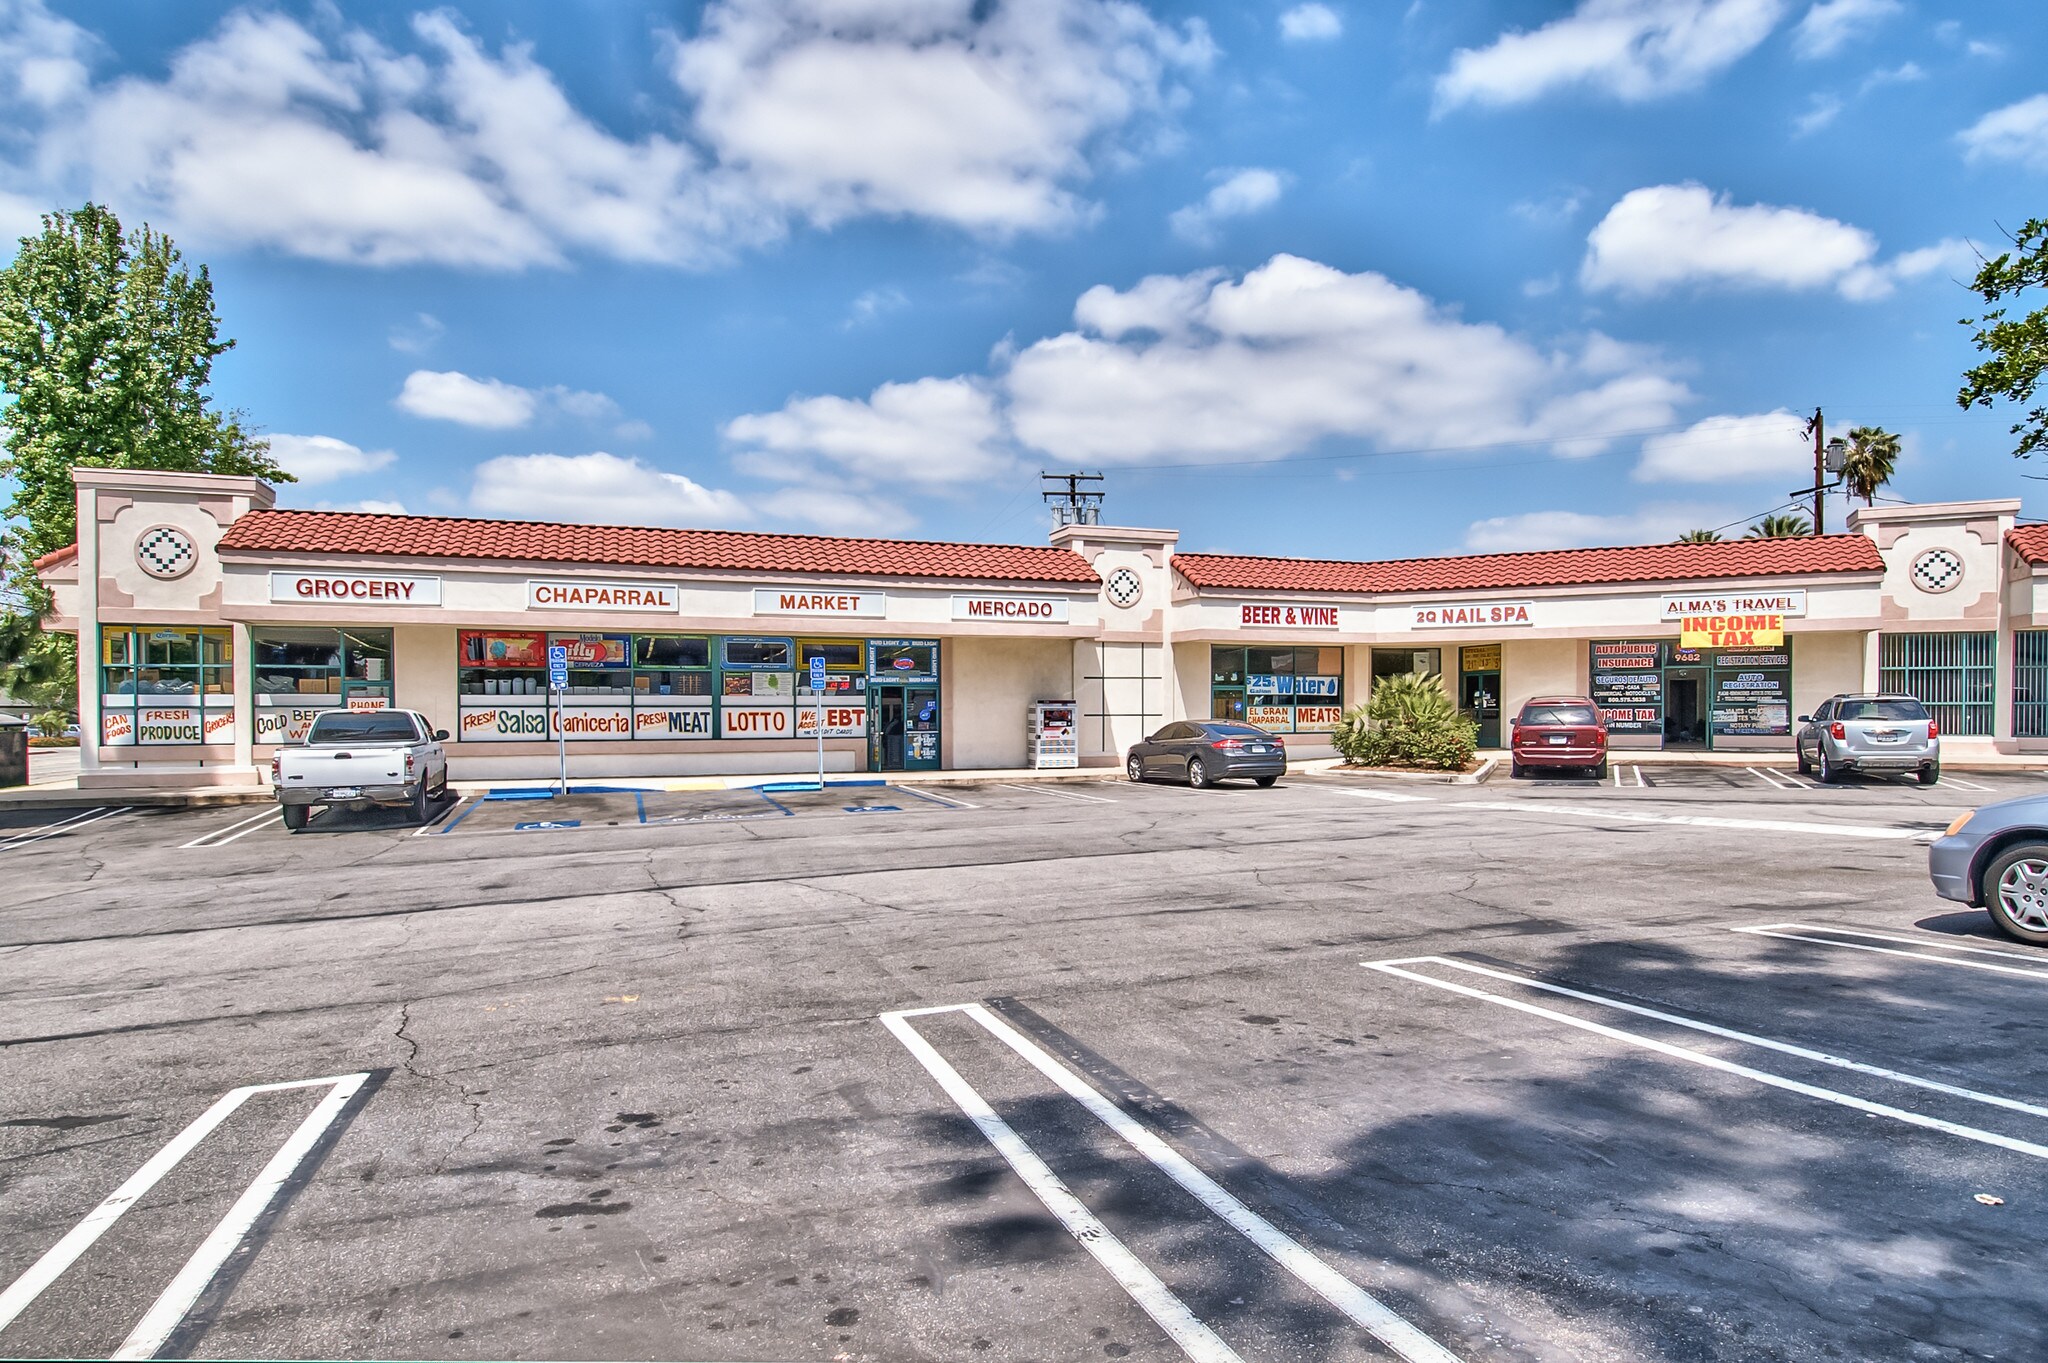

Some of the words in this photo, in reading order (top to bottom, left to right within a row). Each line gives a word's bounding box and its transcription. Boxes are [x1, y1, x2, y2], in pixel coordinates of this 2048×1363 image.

[296, 578, 415, 598] GROCERY
[535, 586, 671, 606] CHAPARRAL
[780, 594, 860, 611] MARKET
[968, 600, 1053, 617] MERCADO
[1668, 600, 1727, 613] ALMA'S
[1732, 597, 1797, 611] TRAVEL
[1242, 605, 1281, 624] BEER
[1285, 606, 1297, 625] &
[1300, 607, 1339, 625] WINE
[1442, 608, 1487, 624] NAIL
[1490, 606, 1529, 622] SPA
[1683, 615, 1781, 632] INCOME
[1708, 631, 1755, 646] TAX
[1598, 658, 1654, 668] INSURANCE
[1674, 653, 1701, 662] 9682
[1716, 656, 1760, 665] REGISTRATION
[1760, 655, 1788, 665] SERVICES
[1276, 675, 1326, 694] Water
[1596, 675, 1628, 684] SEGUROS
[1628, 675, 1639, 684] DE
[1722, 681, 1779, 689] REGISTRATION
[1737, 673, 1764, 681] AUTO
[146, 710, 190, 721] FRESH
[801, 711, 816, 721] WE
[827, 709, 865, 727] EBT
[1249, 708, 1259, 716] EL
[1297, 708, 1341, 723] MEATS
[1600, 709, 1633, 721] NCOME
[1635, 708, 1656, 721] TAX
[104, 714, 128, 730] CAN
[256, 714, 288, 735] COLD
[463, 710, 497, 731] FRESH
[497, 709, 546, 734] Salsa
[636, 711, 668, 730] FRESH
[668, 711, 711, 733] MEAT
[727, 711, 785, 731] LOTTO
[797, 719, 825, 730] ACCET
[1247, 716, 1290, 725] CHAPARRAL
[105, 725, 132, 740] FOODS
[140, 725, 200, 741] PRODUCE
